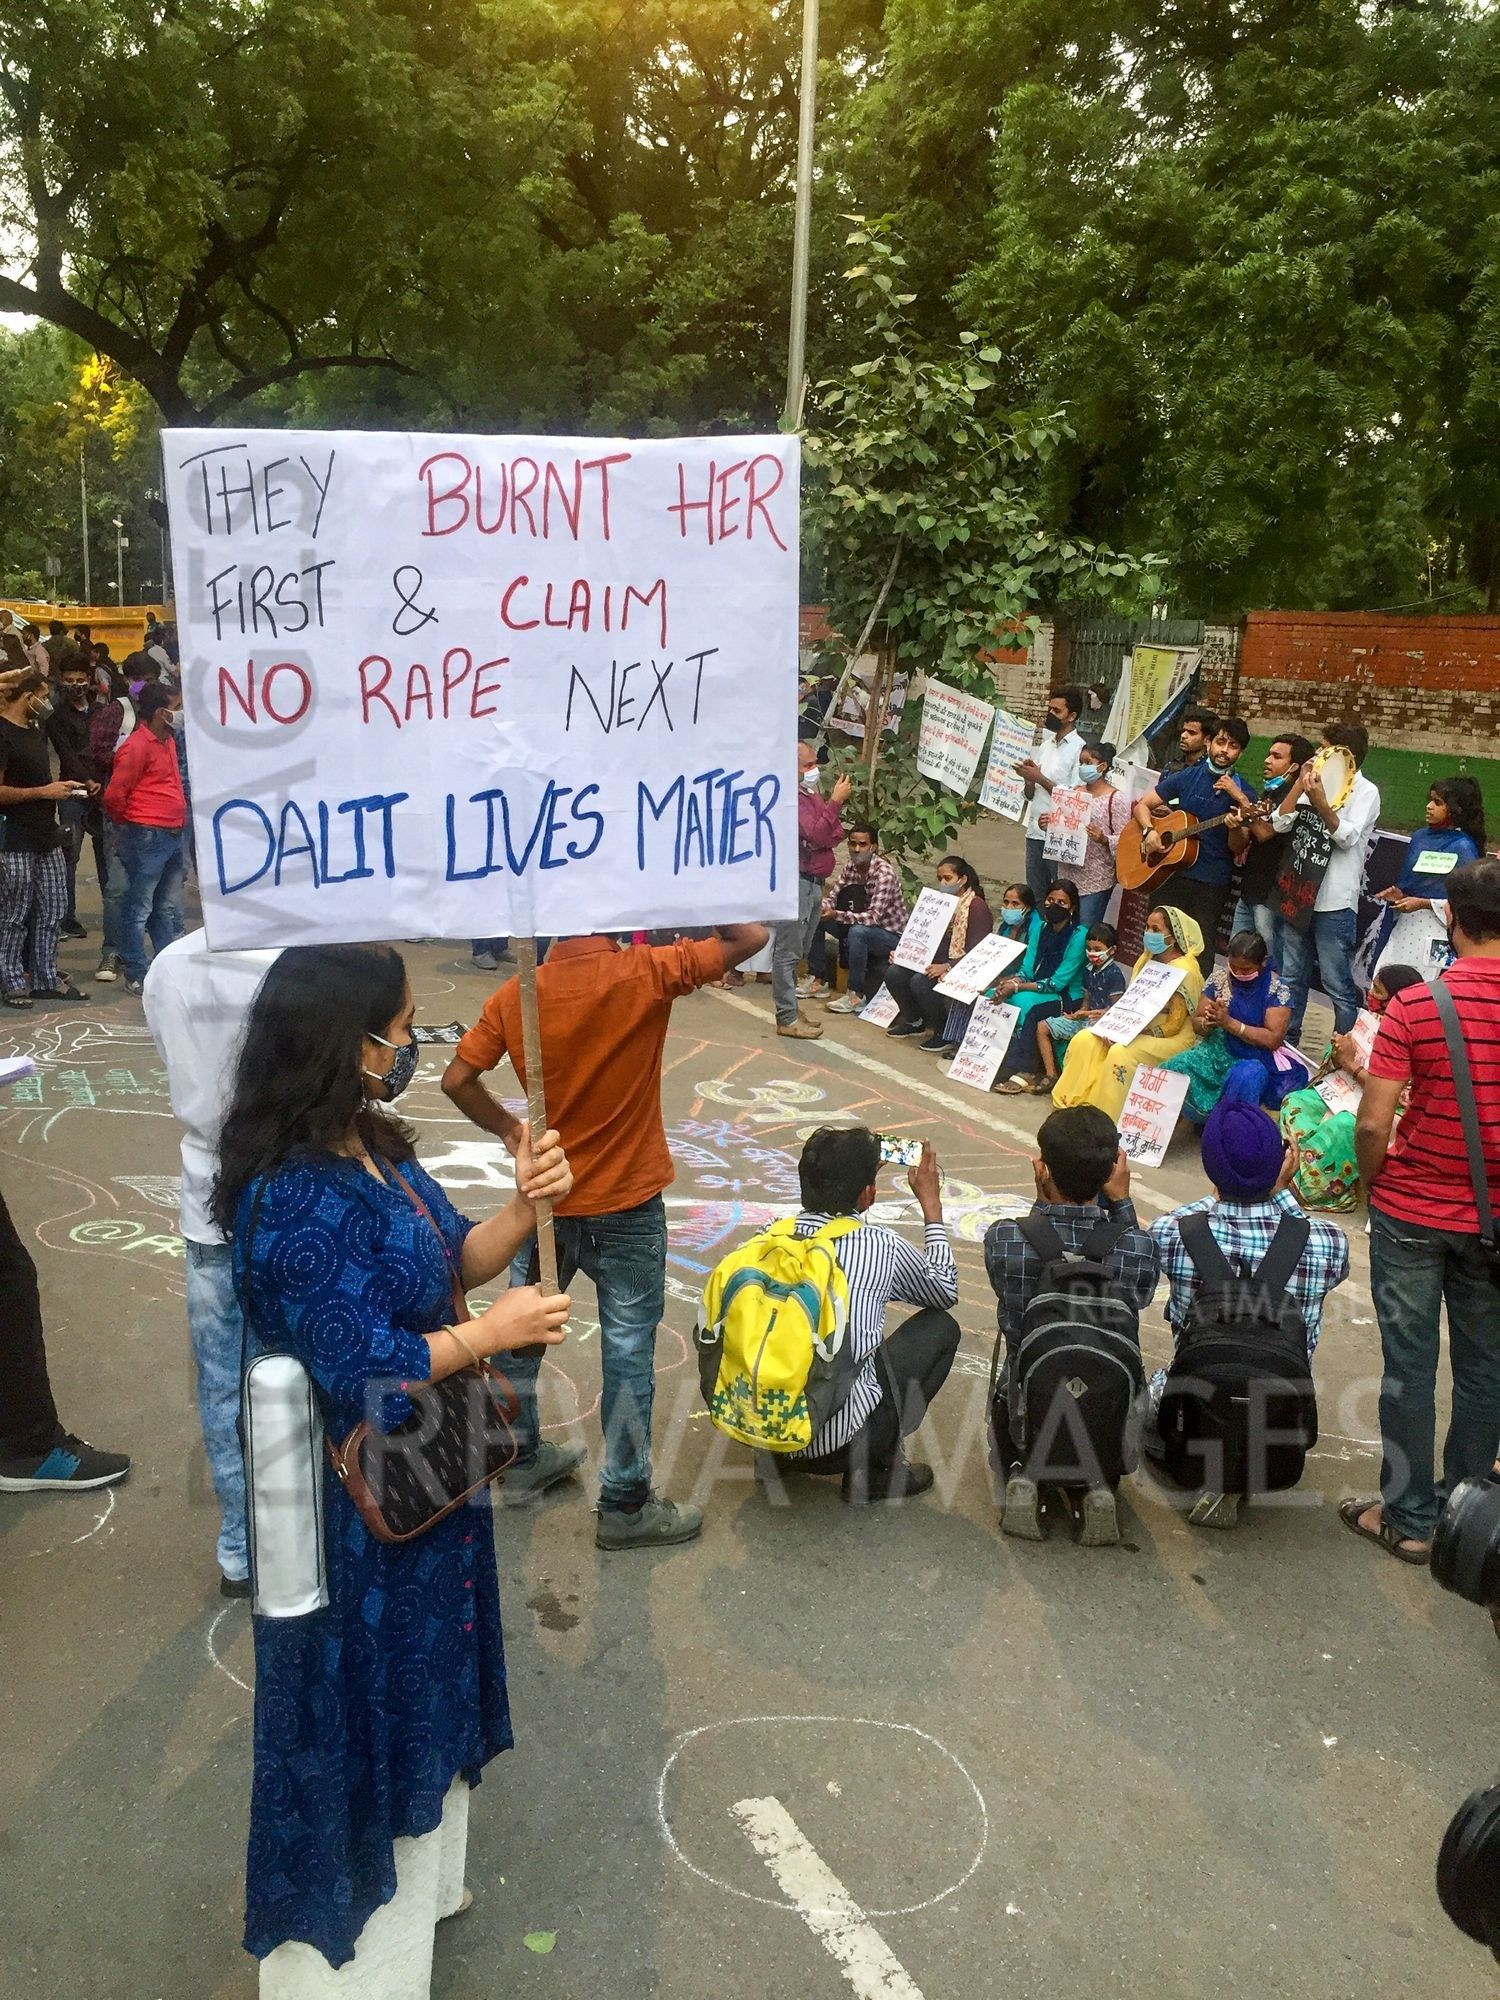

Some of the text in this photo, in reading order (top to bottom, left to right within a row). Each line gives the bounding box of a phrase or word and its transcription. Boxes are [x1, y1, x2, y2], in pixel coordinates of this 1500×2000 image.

[180, 444, 789, 551] THEY BURNT HER
[206, 560, 669, 649] FIRST & CLAIM
[218, 647, 720, 734] NO RAPE NEXT
[211, 768, 781, 897] DALIT LIVES MATTER
[1129, 1092, 1167, 1115] सरकार
[1139, 1067, 1168, 1093] योगी
